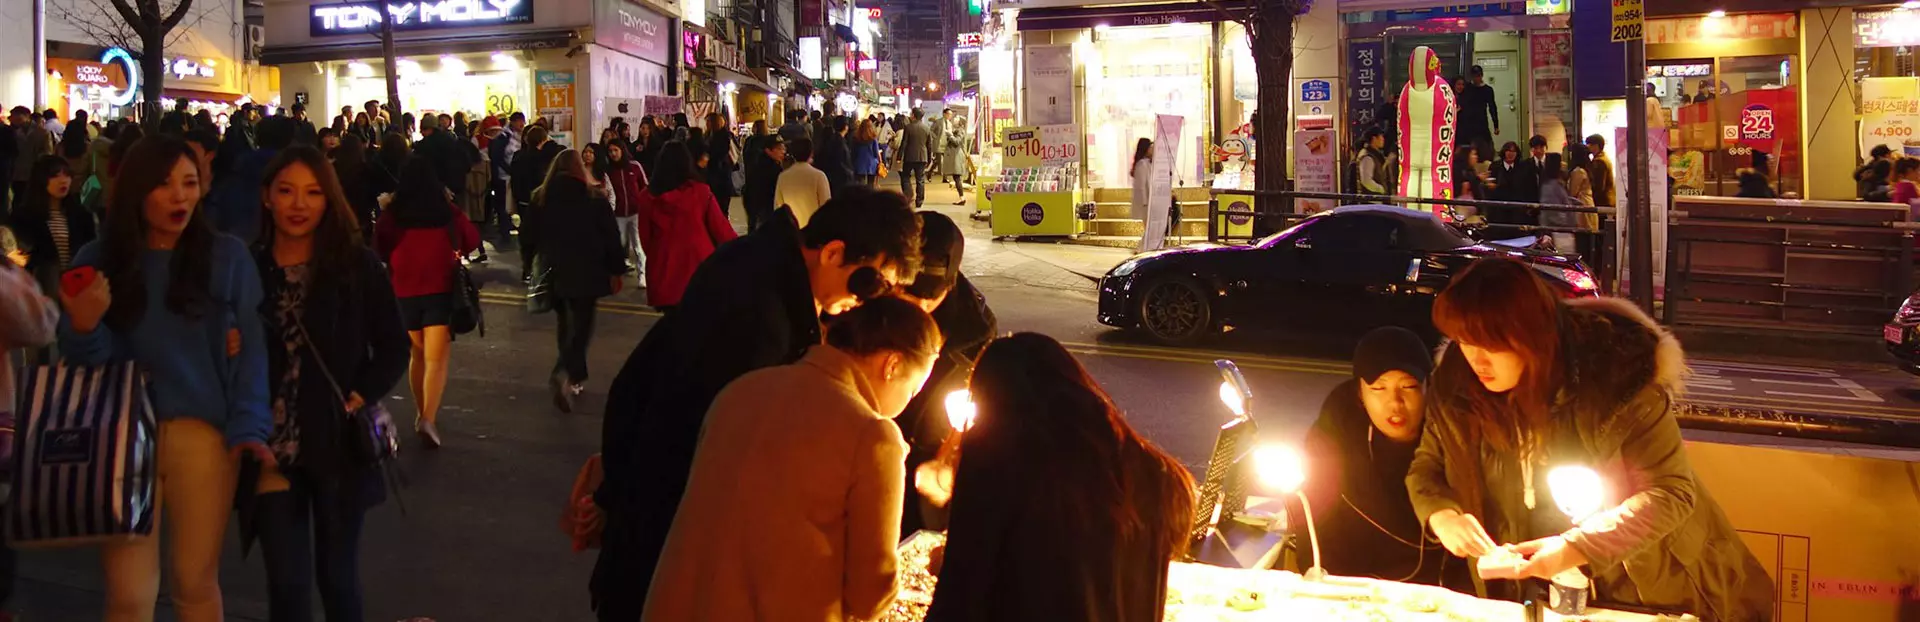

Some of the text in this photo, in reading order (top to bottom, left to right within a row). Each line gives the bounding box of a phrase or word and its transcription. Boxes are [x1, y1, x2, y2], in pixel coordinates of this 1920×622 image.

[314, 0, 520, 30] TONY MOLY
[618, 9, 657, 37] TONYMOLY
[1133, 15, 1186, 25] Holika Holika
[1613, 23, 1642, 40] 2002
[488, 95, 513, 116] 30
[1742, 116, 1774, 134] 24
[1874, 127, 1912, 137] 4,900
[1677, 188, 1704, 197] CHEESY
